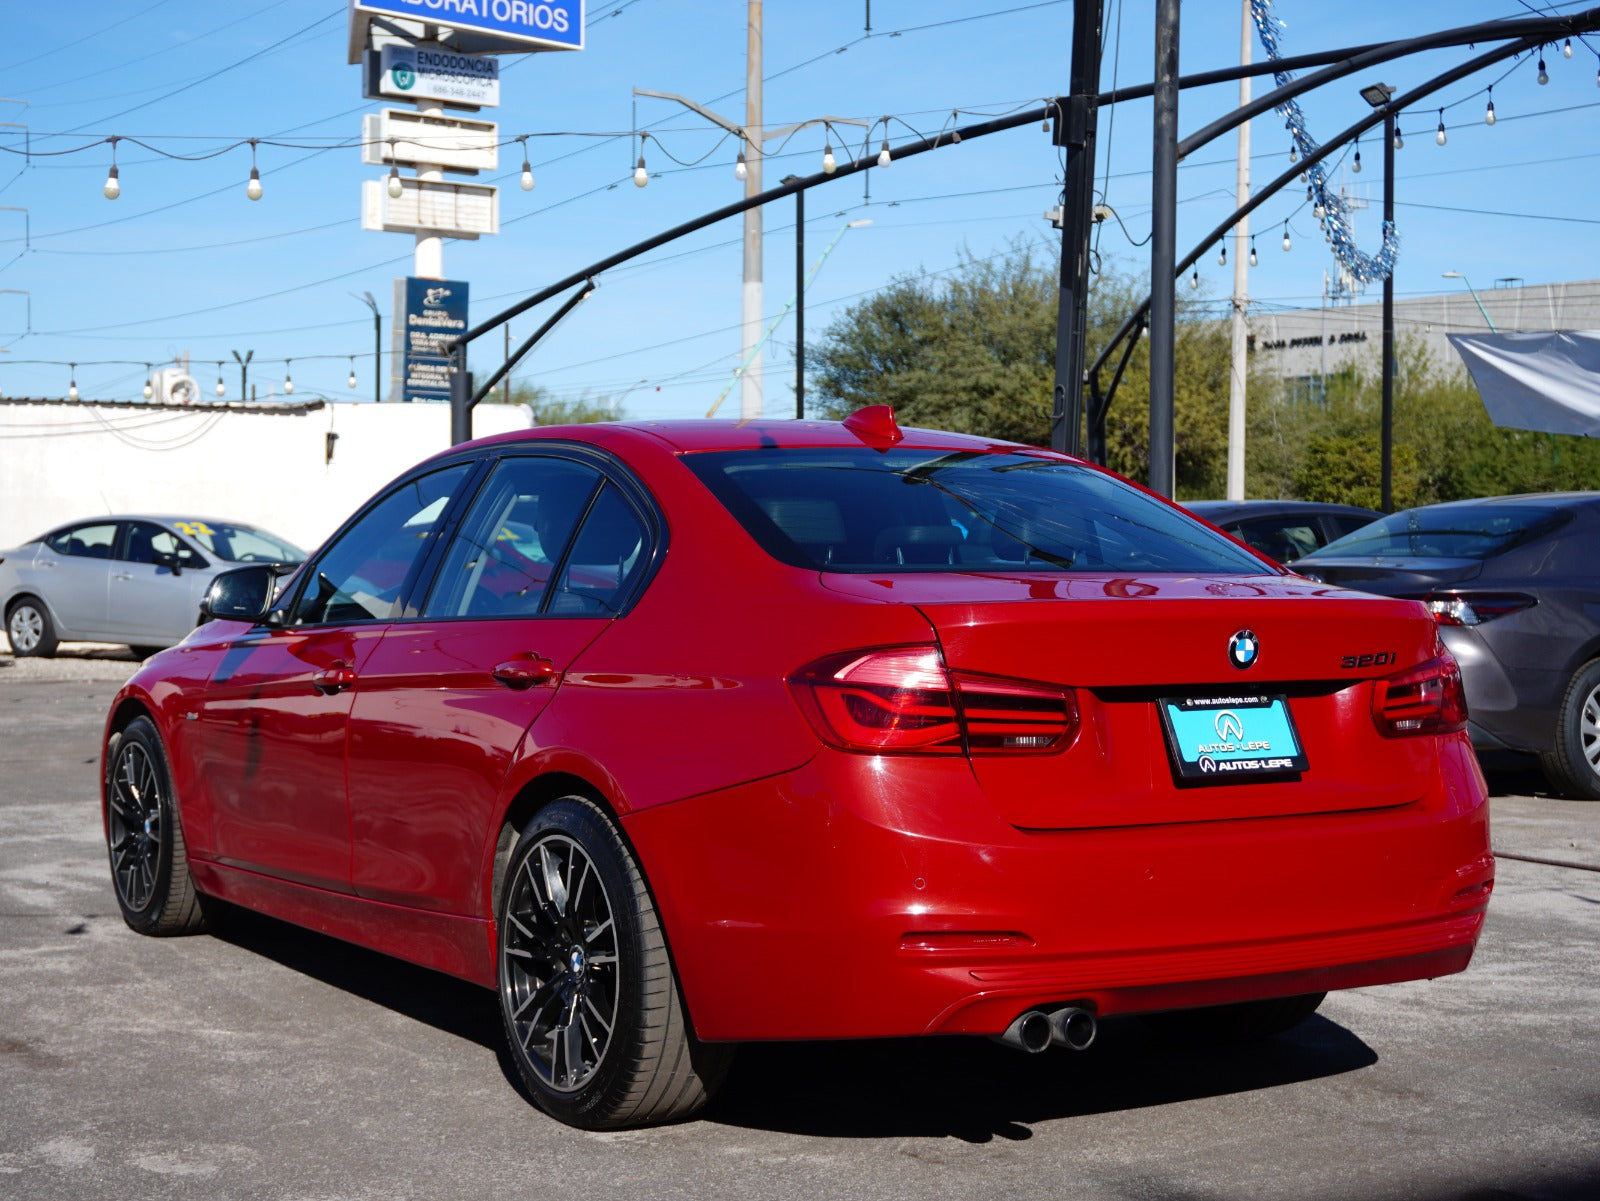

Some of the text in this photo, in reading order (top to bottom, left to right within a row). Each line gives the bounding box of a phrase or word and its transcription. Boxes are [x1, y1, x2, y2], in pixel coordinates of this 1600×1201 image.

[417, 51, 494, 74] ENDODONCIA
[173, 521, 215, 536] 22
[1340, 651, 1396, 669] 320i
[1193, 695, 1260, 707] www.autoslepe.com
